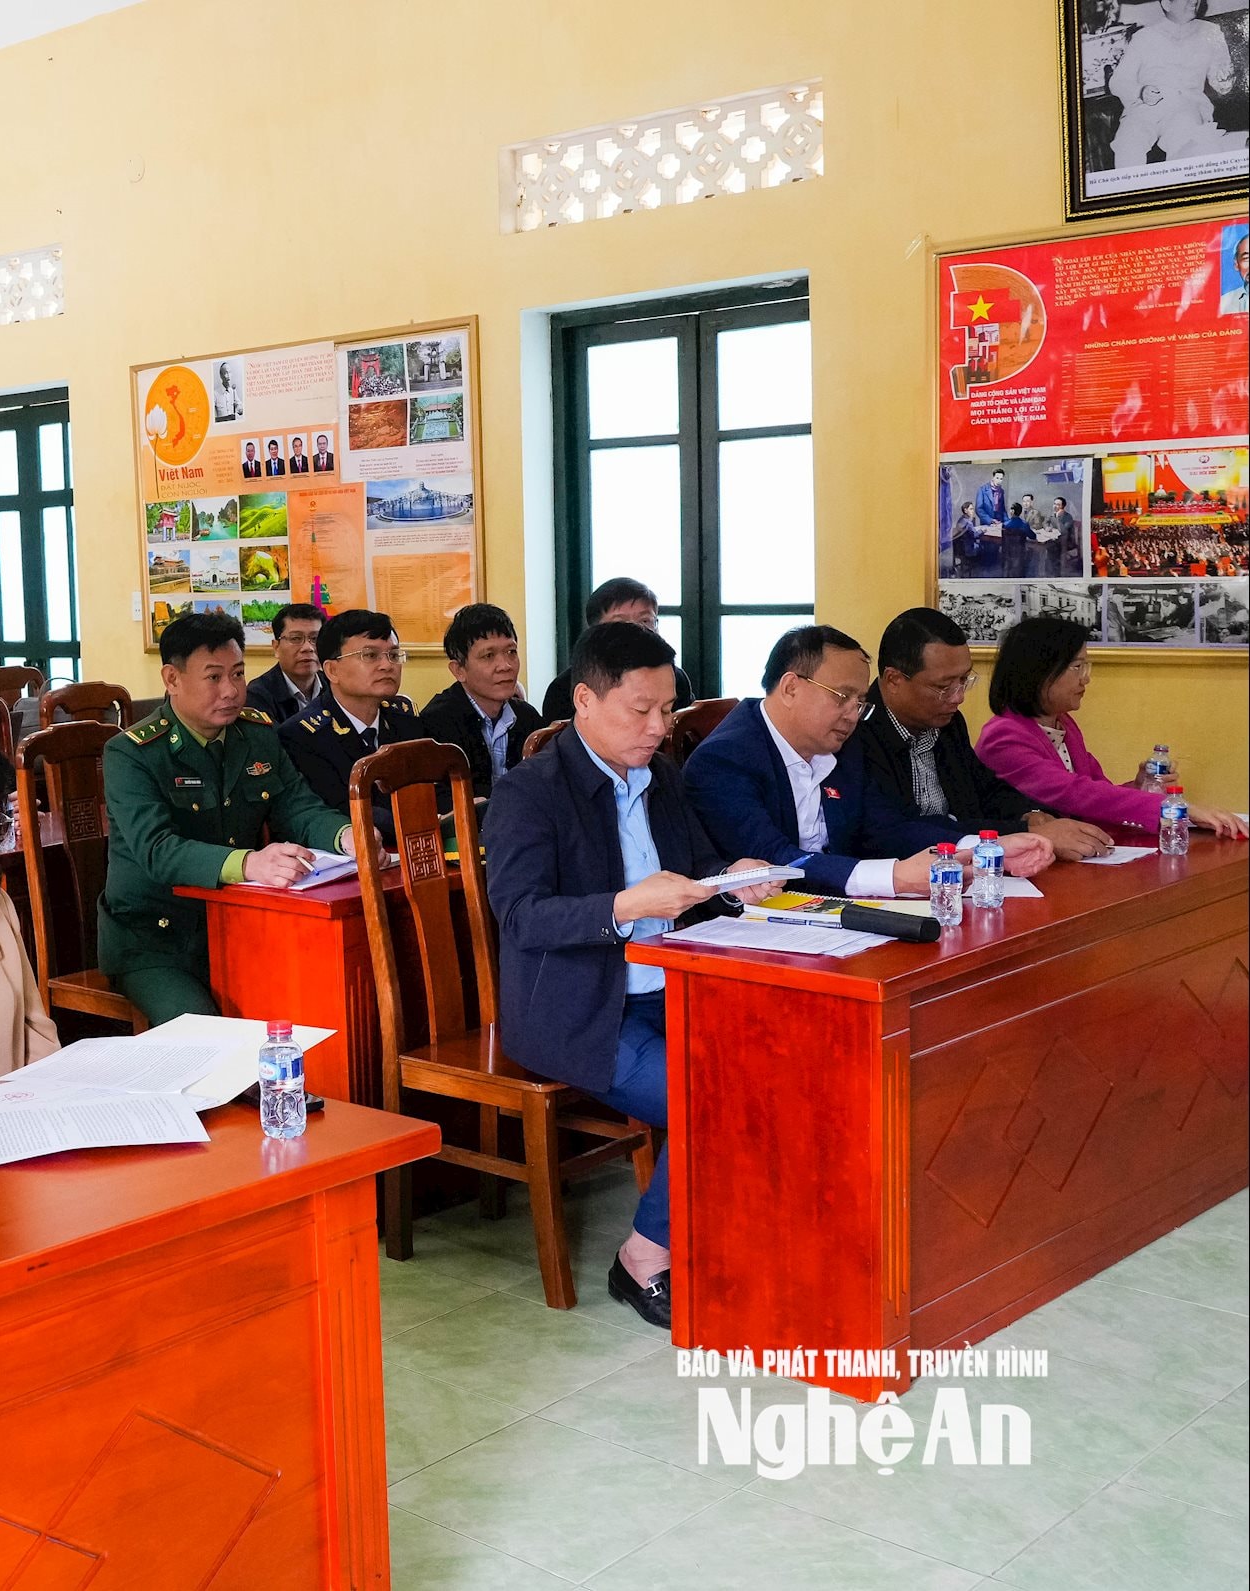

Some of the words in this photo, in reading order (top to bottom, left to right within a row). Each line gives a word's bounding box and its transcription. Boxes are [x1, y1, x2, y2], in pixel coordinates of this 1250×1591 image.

[1085, 341, 1109, 349] NHỮNG
[1111, 338, 1137, 347] CHẶNG
[1139, 335, 1166, 344] ĐƯỜNG
[1178, 332, 1200, 340] VANG
[1202, 330, 1217, 338] CỦA
[1220, 328, 1243, 336] ĐẢNG
[986, 406, 1012, 414] THẮNG
[1015, 406, 1027, 414] LỢI
[1029, 403, 1046, 411] CỦA
[1014, 413, 1028, 422] VIỆT
[158, 468, 179, 482] Việt
[181, 467, 204, 479] Nam
